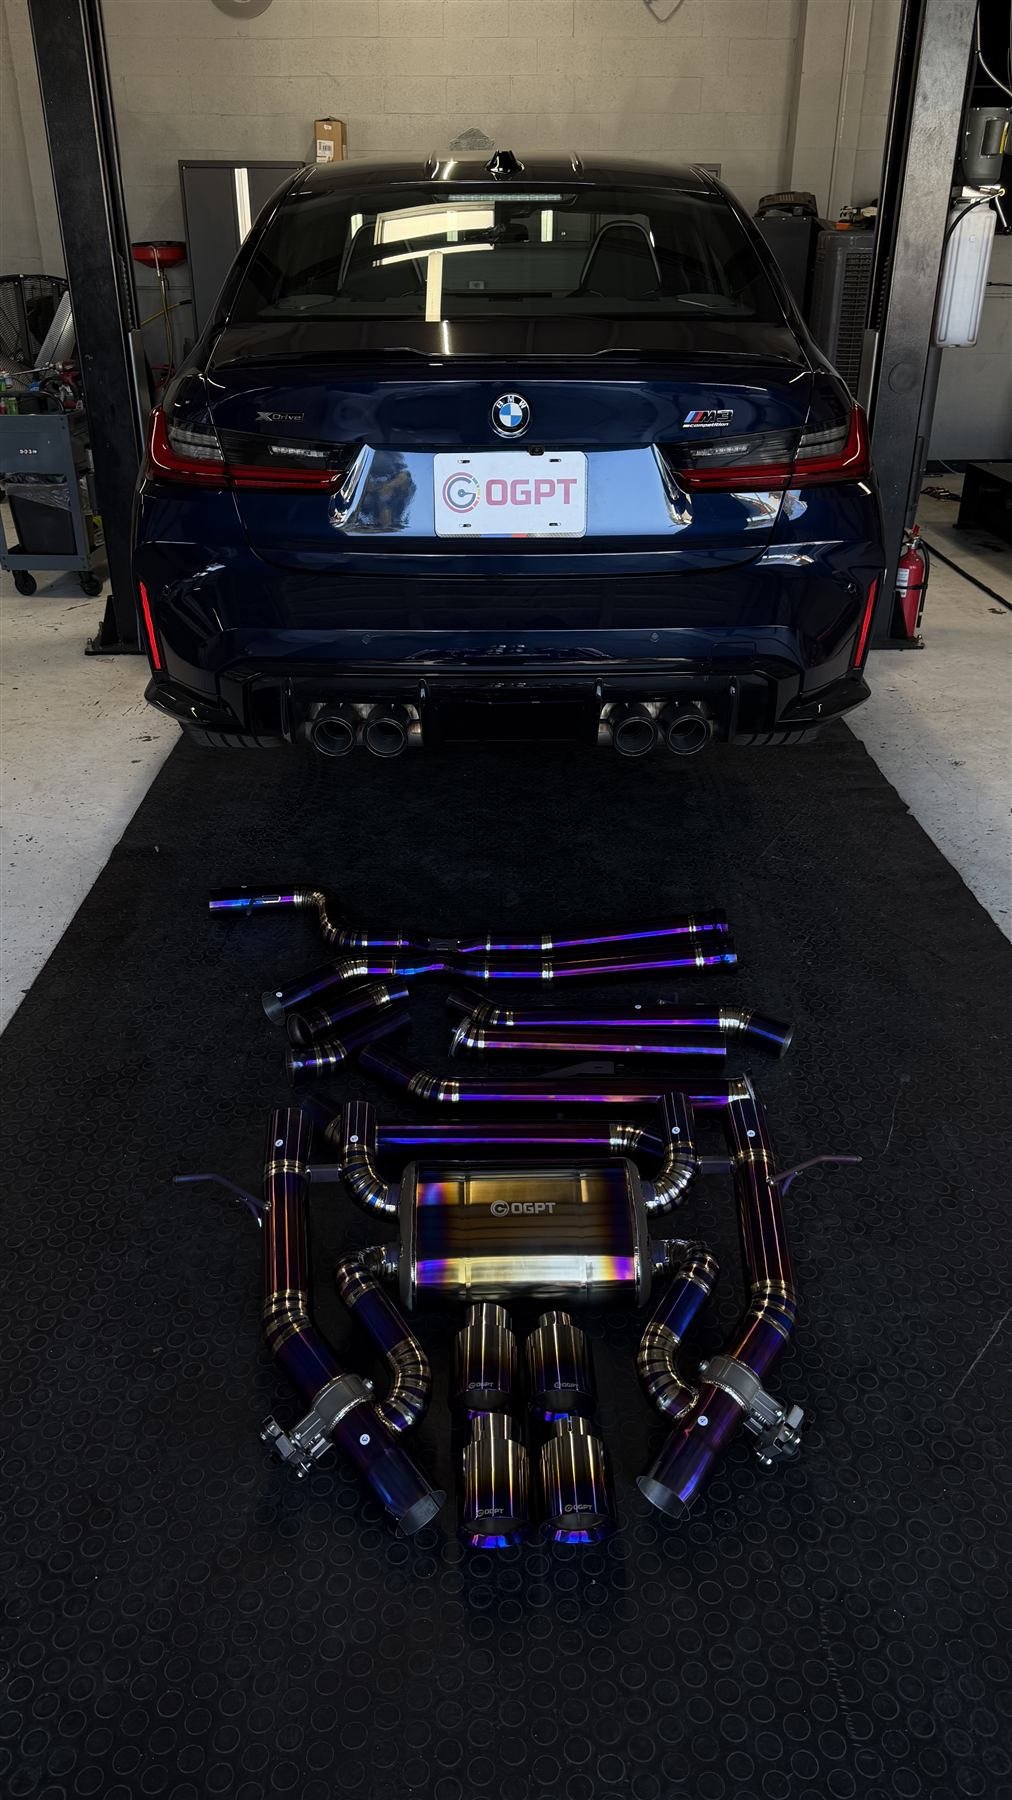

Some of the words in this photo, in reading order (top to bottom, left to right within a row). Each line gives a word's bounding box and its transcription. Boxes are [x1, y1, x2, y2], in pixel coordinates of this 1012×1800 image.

[698, 409, 734, 423] M3
[485, 478, 578, 506] OGPT
[511, 1202, 557, 1214] OGPT
